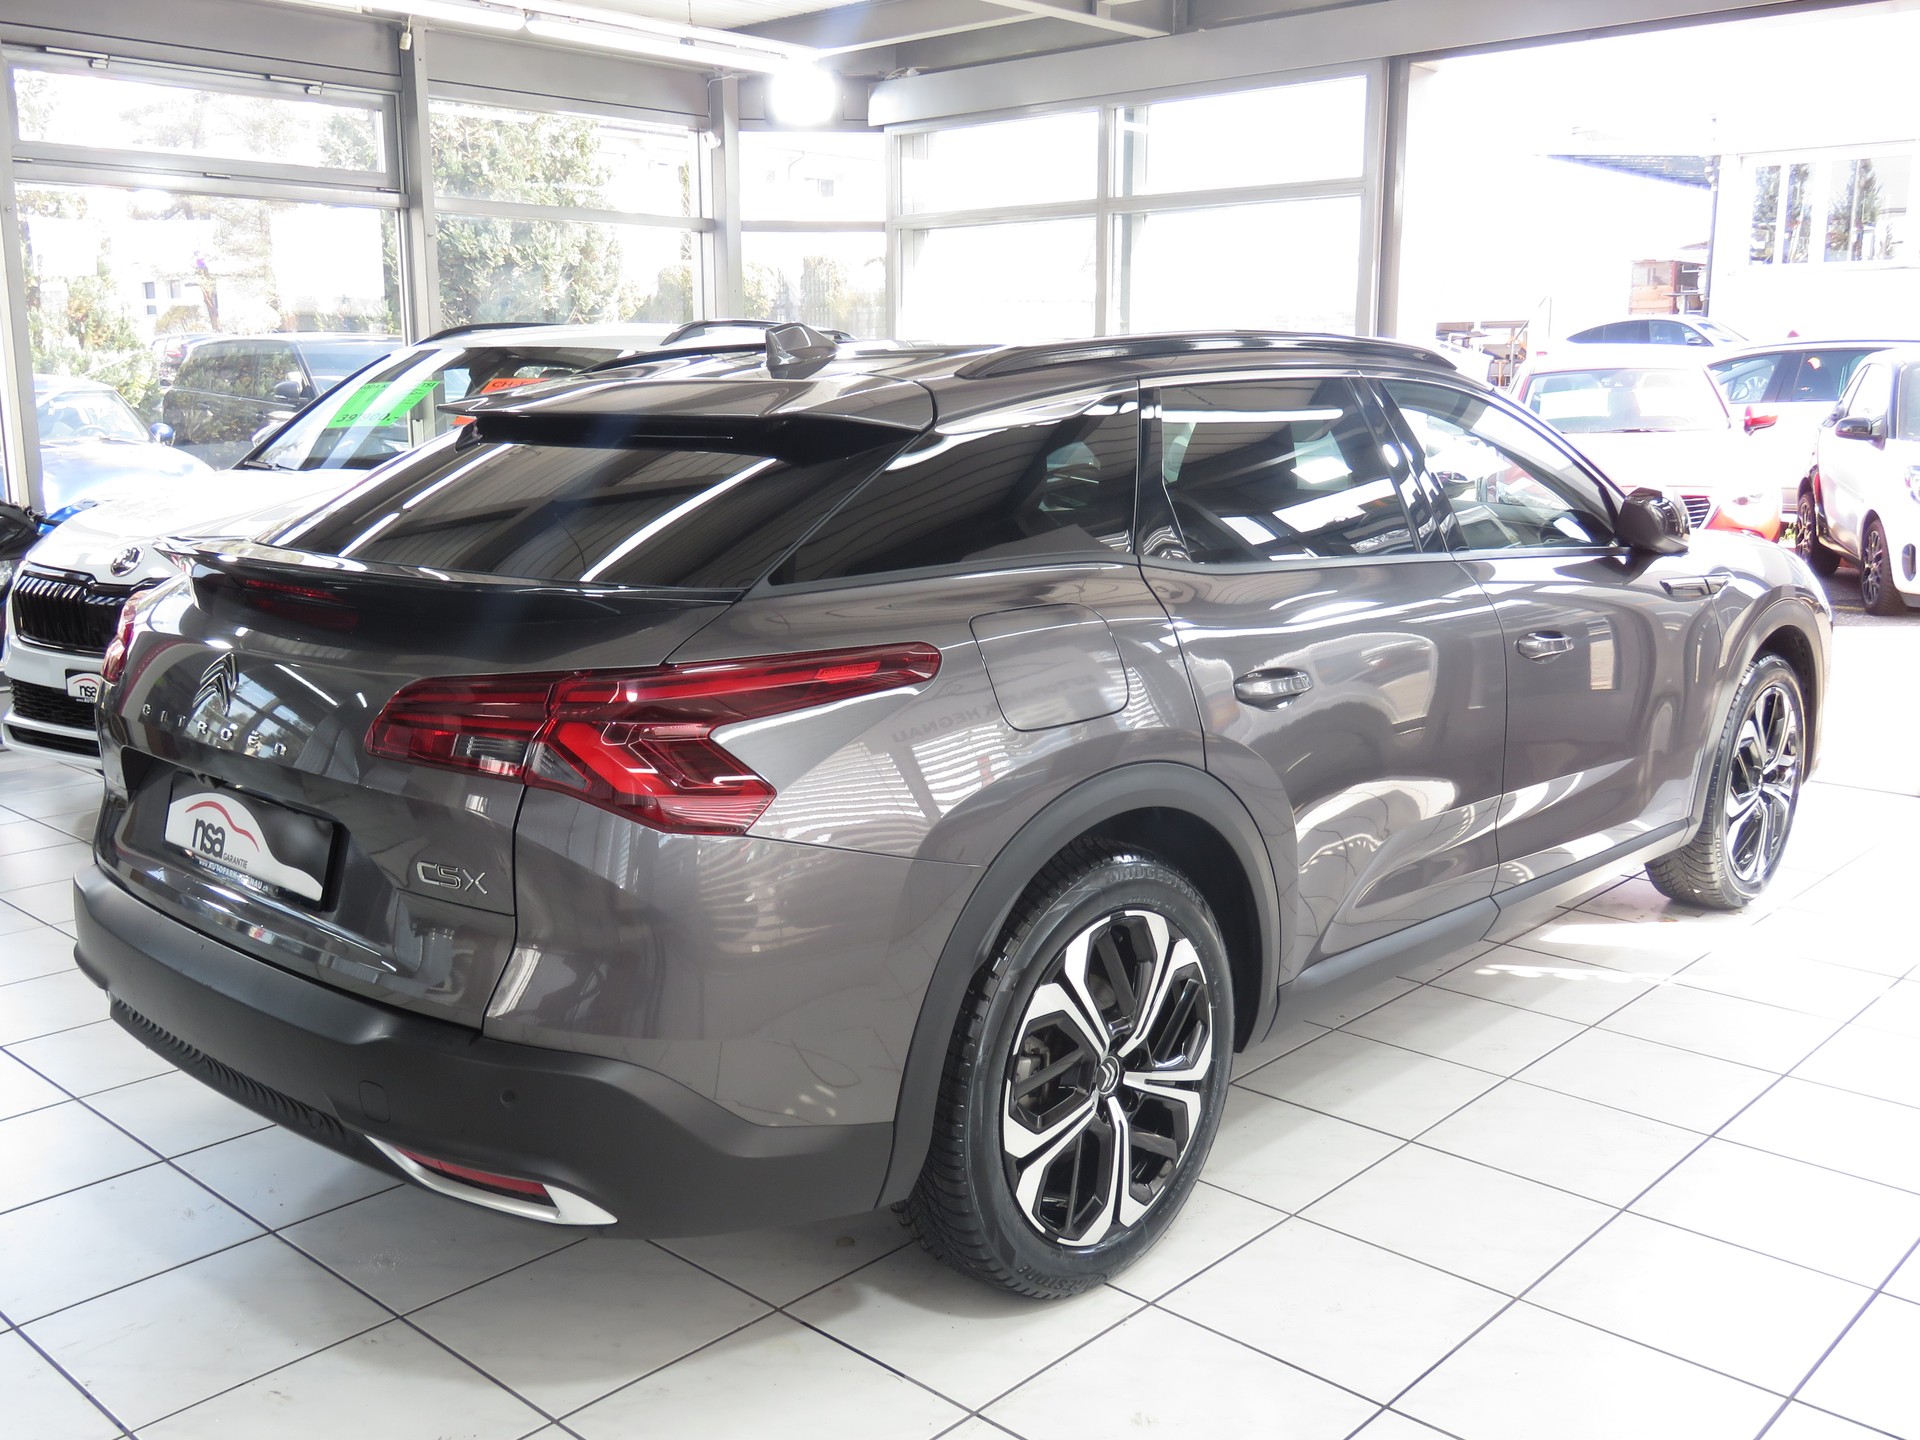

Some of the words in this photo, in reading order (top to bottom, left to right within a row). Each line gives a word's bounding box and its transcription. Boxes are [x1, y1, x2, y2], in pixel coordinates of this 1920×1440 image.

[79, 684, 97, 698] nsa
[192, 818, 226, 861] nsa
[222, 852, 249, 870] GARANTIE
[416, 861, 488, 895] C5X
